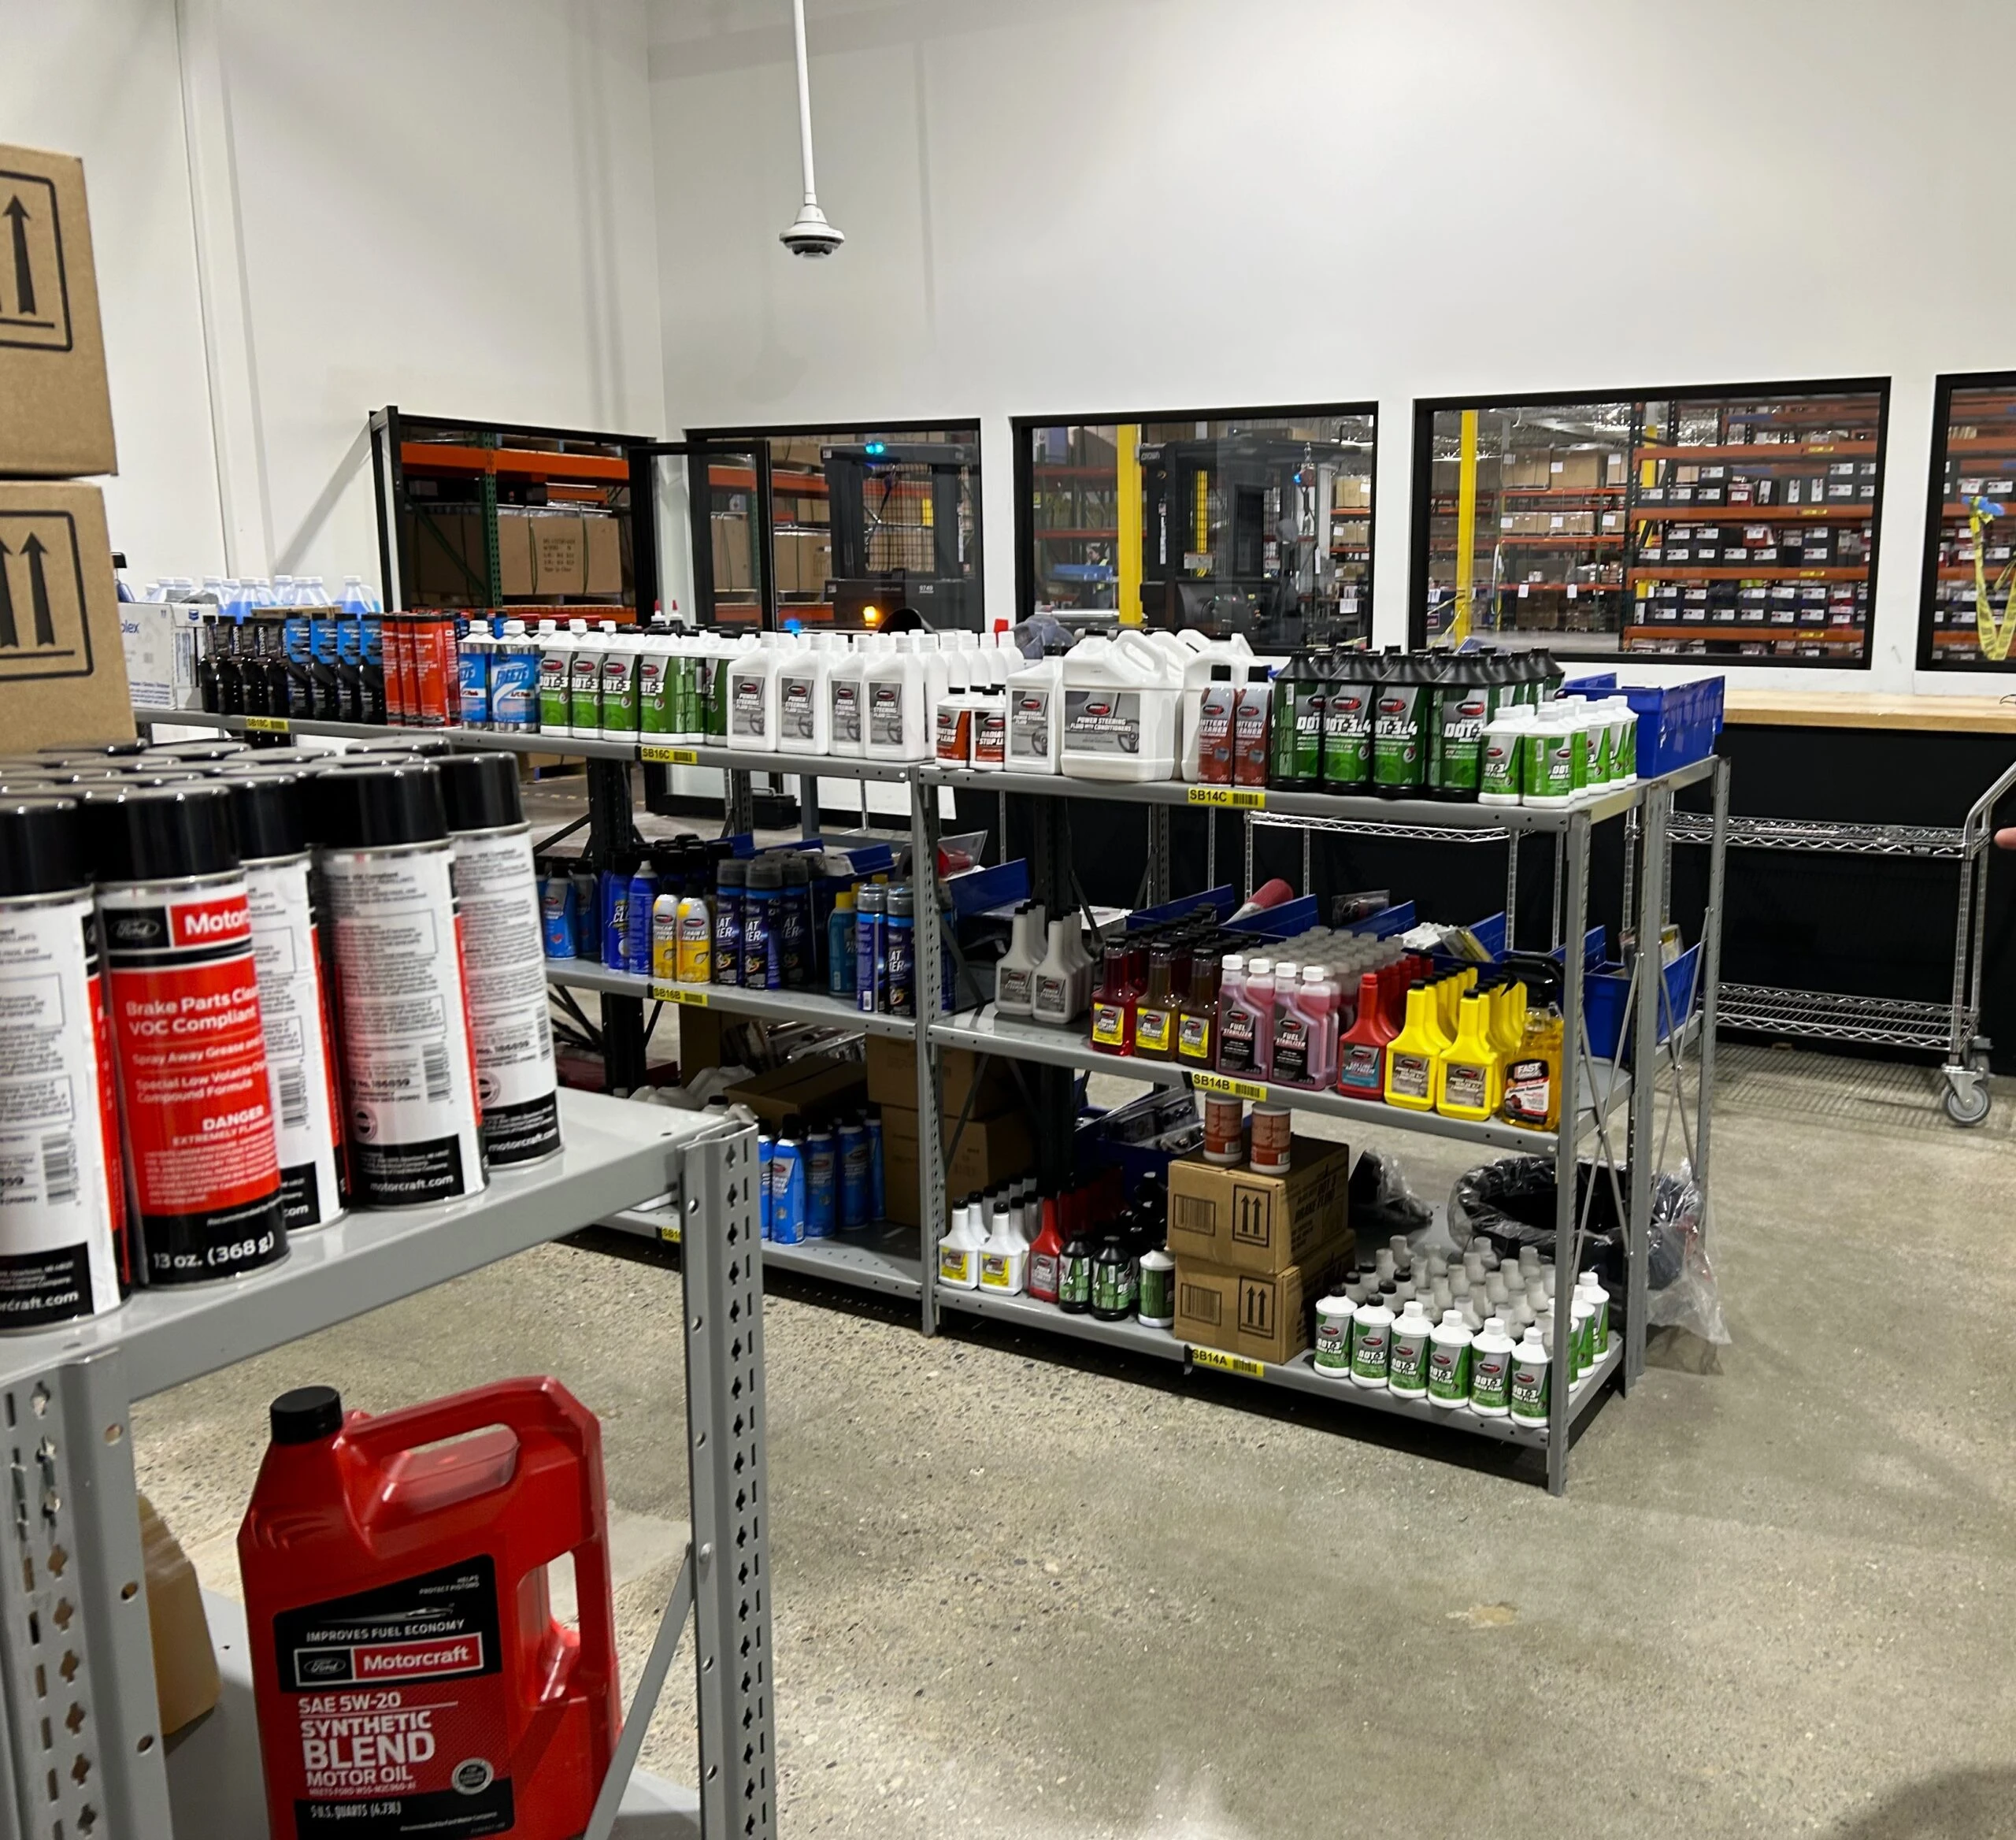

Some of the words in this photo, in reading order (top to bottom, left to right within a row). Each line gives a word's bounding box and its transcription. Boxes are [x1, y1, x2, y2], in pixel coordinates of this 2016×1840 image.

[643, 748, 669, 759] SB16C
[1190, 789, 1227, 803] SB14C
[125, 1000, 178, 1017] Brake
[180, 992, 231, 1013] Parts
[128, 1020, 169, 1036] VOC
[172, 1004, 257, 1033] Compliant
[1229, 1022, 1246, 1031] FUEL
[1223, 1027, 1253, 1038] STABILIZER
[1276, 1037, 1306, 1048] STABILIZER
[1282, 1031, 1299, 1041] FUEL
[1518, 1062, 1542, 1072] FAST
[1193, 1074, 1230, 1090] SB14B
[202, 1104, 265, 1132] DANGER
[487, 1127, 558, 1152] motorcraft.com
[369, 1174, 454, 1193] motorcraft.com
[154, 1253, 171, 1269] 13
[174, 1254, 203, 1269] oz.
[207, 1239, 256, 1266] (368
[258, 1230, 275, 1255] g)
[1192, 1348, 1228, 1367] SB14A
[306, 1627, 369, 1643] IMPROVES
[371, 1624, 402, 1638] FUEL
[404, 1619, 465, 1636] ECONOMY
[362, 1645, 470, 1672] Motorcraft
[298, 1695, 337, 1714] SAE
[339, 1691, 402, 1711] 5W-20
[300, 1710, 432, 1738] SYNTHETIC
[302, 1731, 436, 1771] BLEND
[306, 1768, 377, 1788] MOTOR
[380, 1765, 414, 1782] OIL
[334, 1803, 369, 1820] QUARTS
